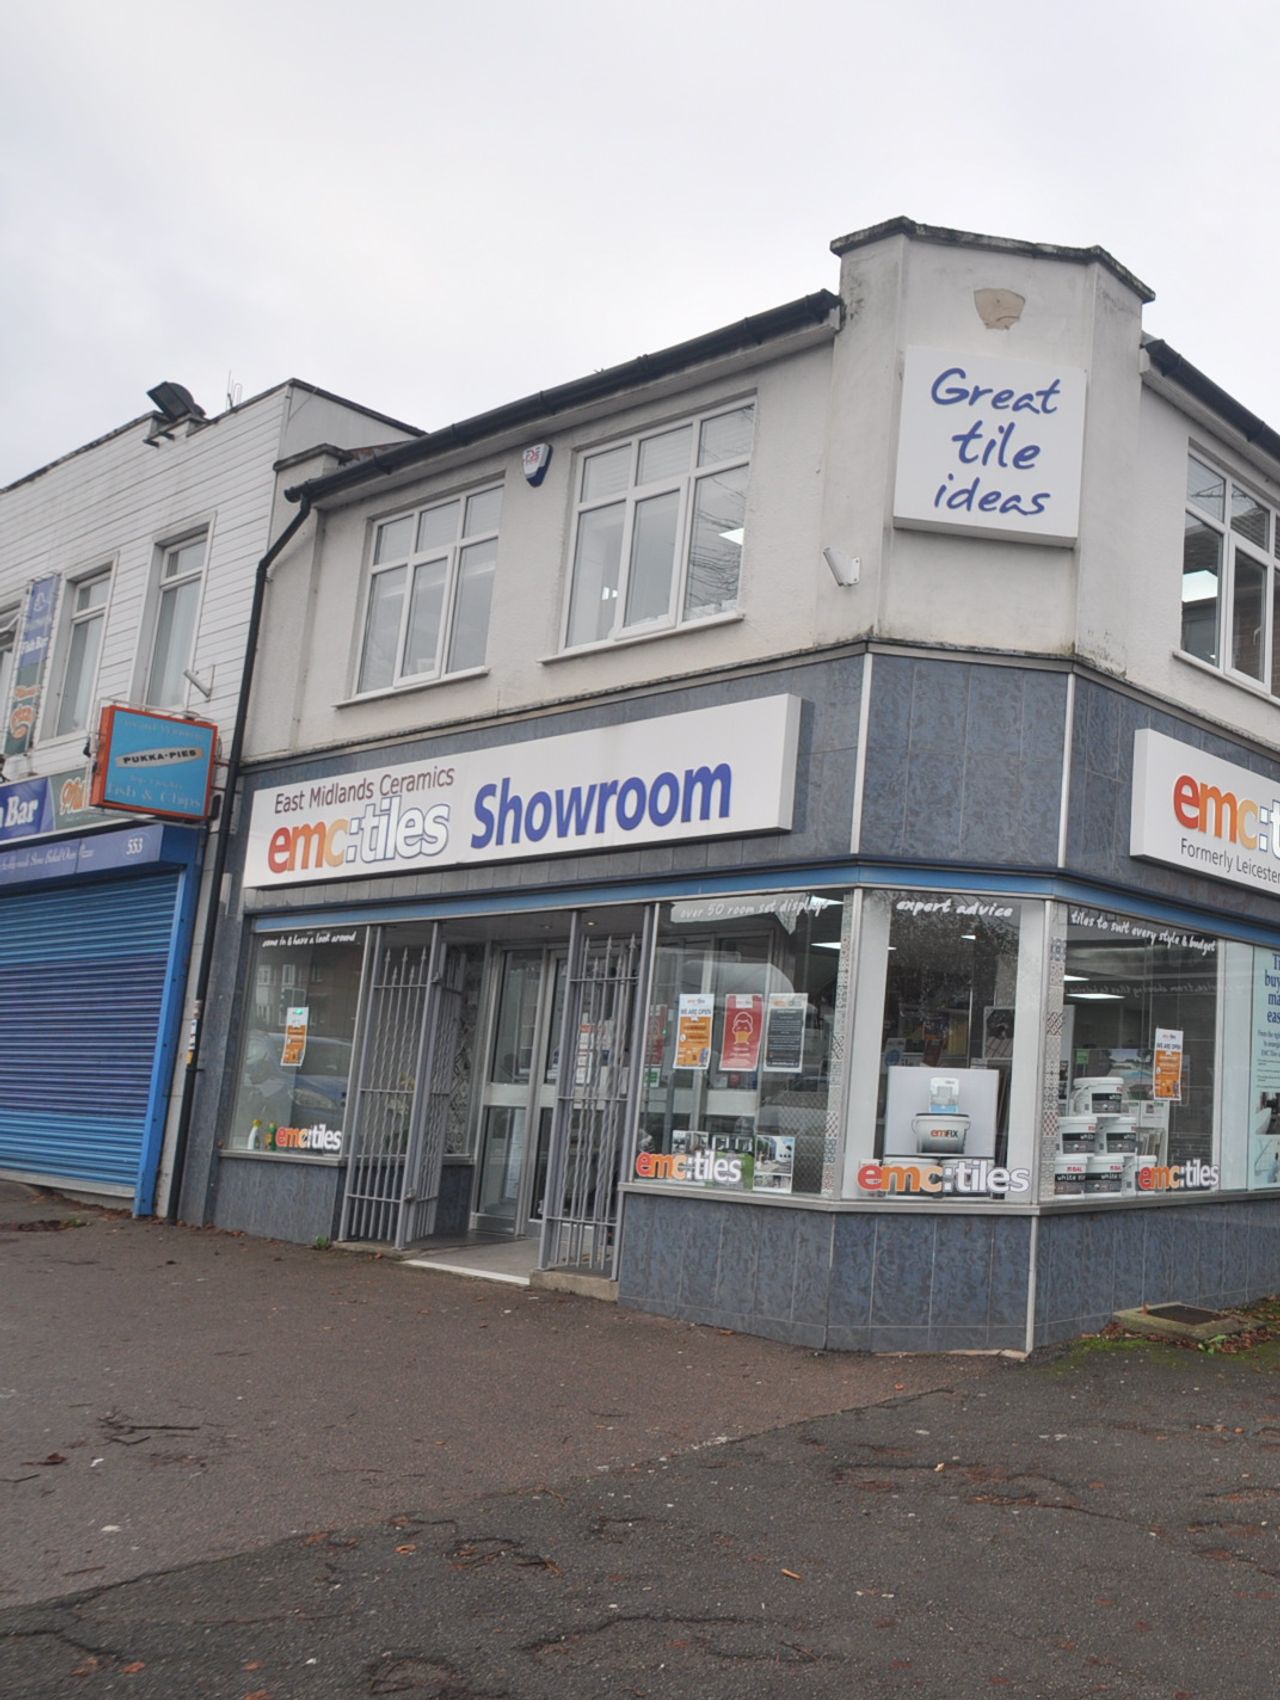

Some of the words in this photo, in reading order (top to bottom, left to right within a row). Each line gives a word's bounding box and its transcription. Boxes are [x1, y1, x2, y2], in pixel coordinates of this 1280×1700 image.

[931, 367, 1061, 414] Great
[951, 420, 1041, 470] tile
[934, 473, 1051, 516] ideas
[274, 791, 305, 814] East
[308, 778, 374, 810] Midlands
[379, 764, 456, 797] Ceramics
[470, 762, 732, 850] Showroom
[4, 795, 39, 828] Bar
[126, 837, 144, 856] 553
[267, 796, 451, 875] emc:tiles
[1180, 837, 1233, 873] Formerly
[680, 908, 703, 919] over
[707, 903, 725, 917] 50
[727, 906, 755, 916] room
[759, 901, 777, 914] set
[779, 898, 829, 918] displays
[896, 898, 952, 916] expert
[956, 902, 1014, 918] advice
[279, 935, 287, 946] in
[293, 933, 308, 946] have
[315, 932, 331, 944] look
[331, 930, 357, 943] around
[1071, 910, 1095, 927] tiles
[1097, 916, 1108, 929] to
[1111, 921, 1131, 935] suit
[1131, 927, 1157, 945] every
[1158, 930, 1180, 949] style
[1189, 935, 1216, 956] budget
[635, 1150, 742, 1183] emc:tiles
[857, 1159, 1032, 1194] emc:tiles
[1138, 1157, 1220, 1190] emc:tiles
